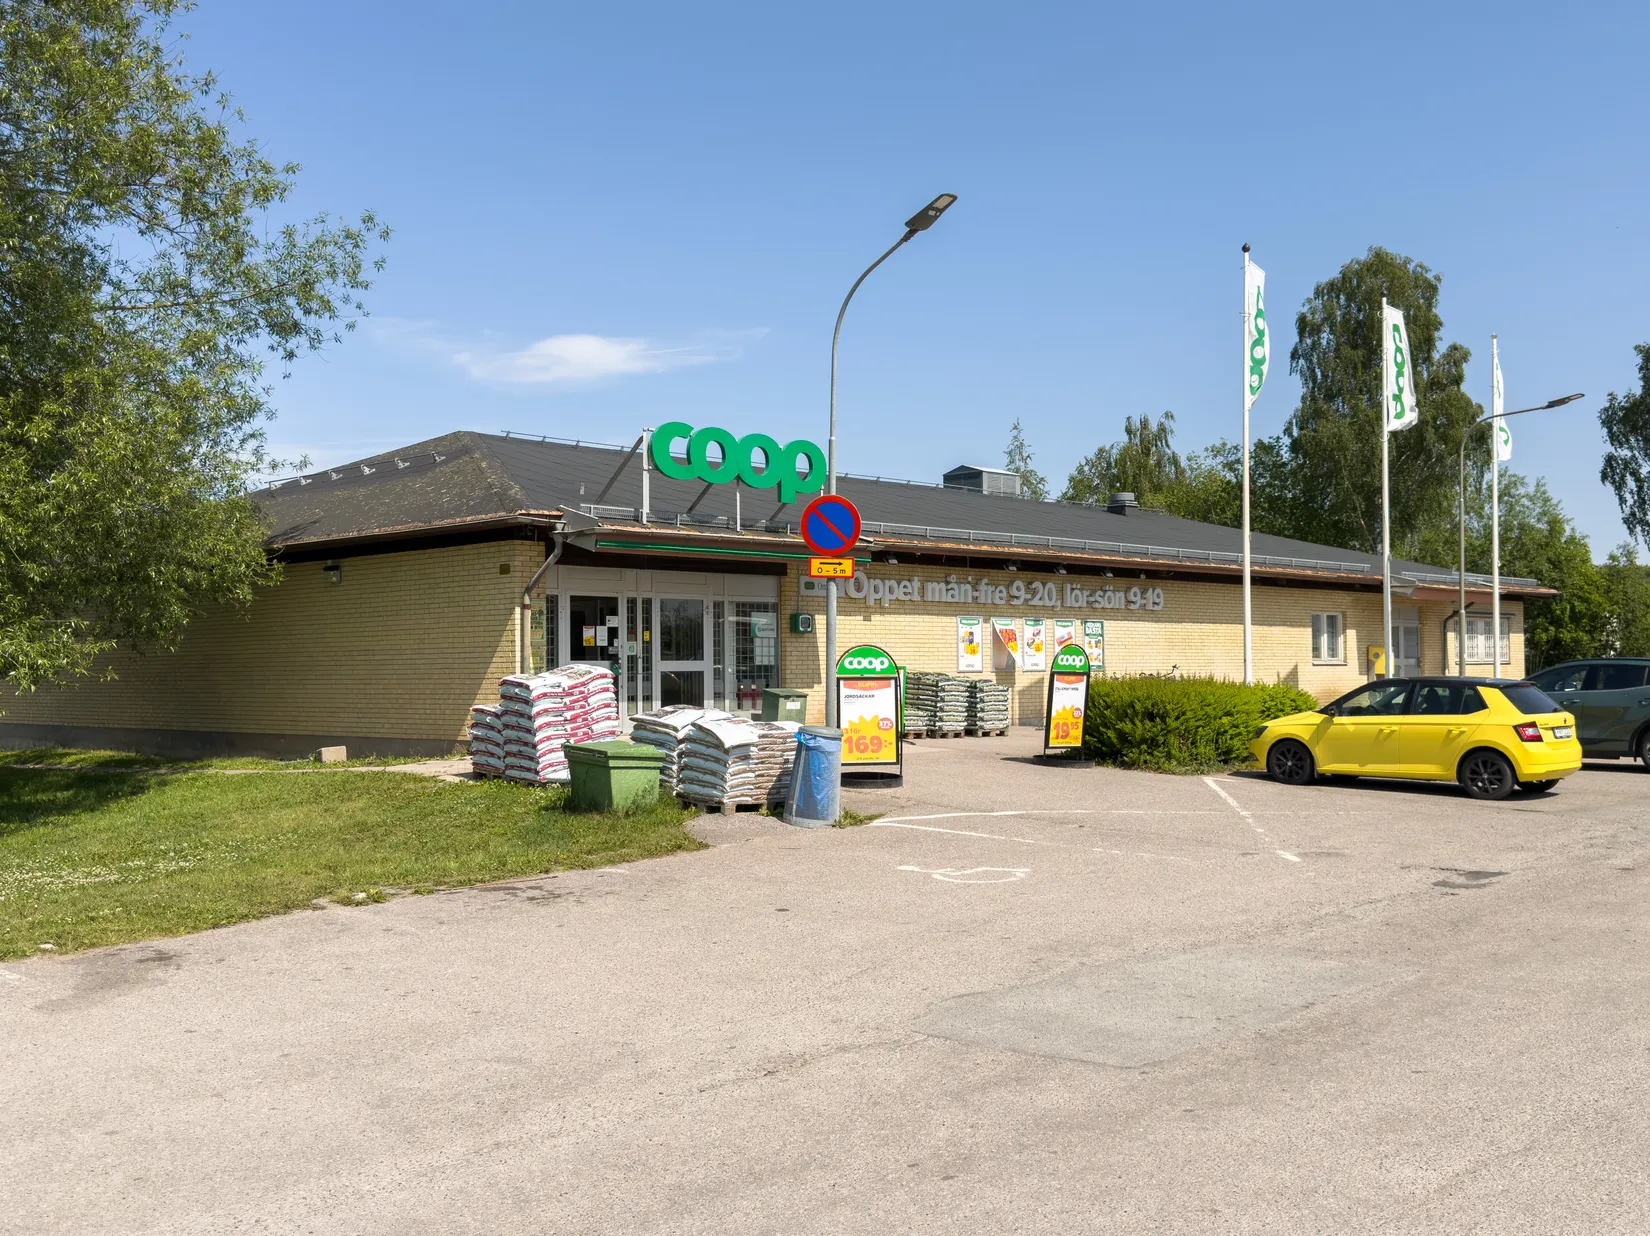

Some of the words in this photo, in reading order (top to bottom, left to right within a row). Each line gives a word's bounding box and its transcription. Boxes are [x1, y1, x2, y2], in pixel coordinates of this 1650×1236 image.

[1392, 323, 1406, 419] coop
[650, 421, 827, 504] coop
[845, 567, 921, 606] Öppet
[924, 574, 1007, 604] mån-fre
[1009, 580, 1061, 610] 9-20,
[1062, 583, 1125, 609] lör-sön
[1126, 586, 1164, 610] 9-19
[843, 657, 889, 672] coop
[1057, 654, 1085, 668] coop
